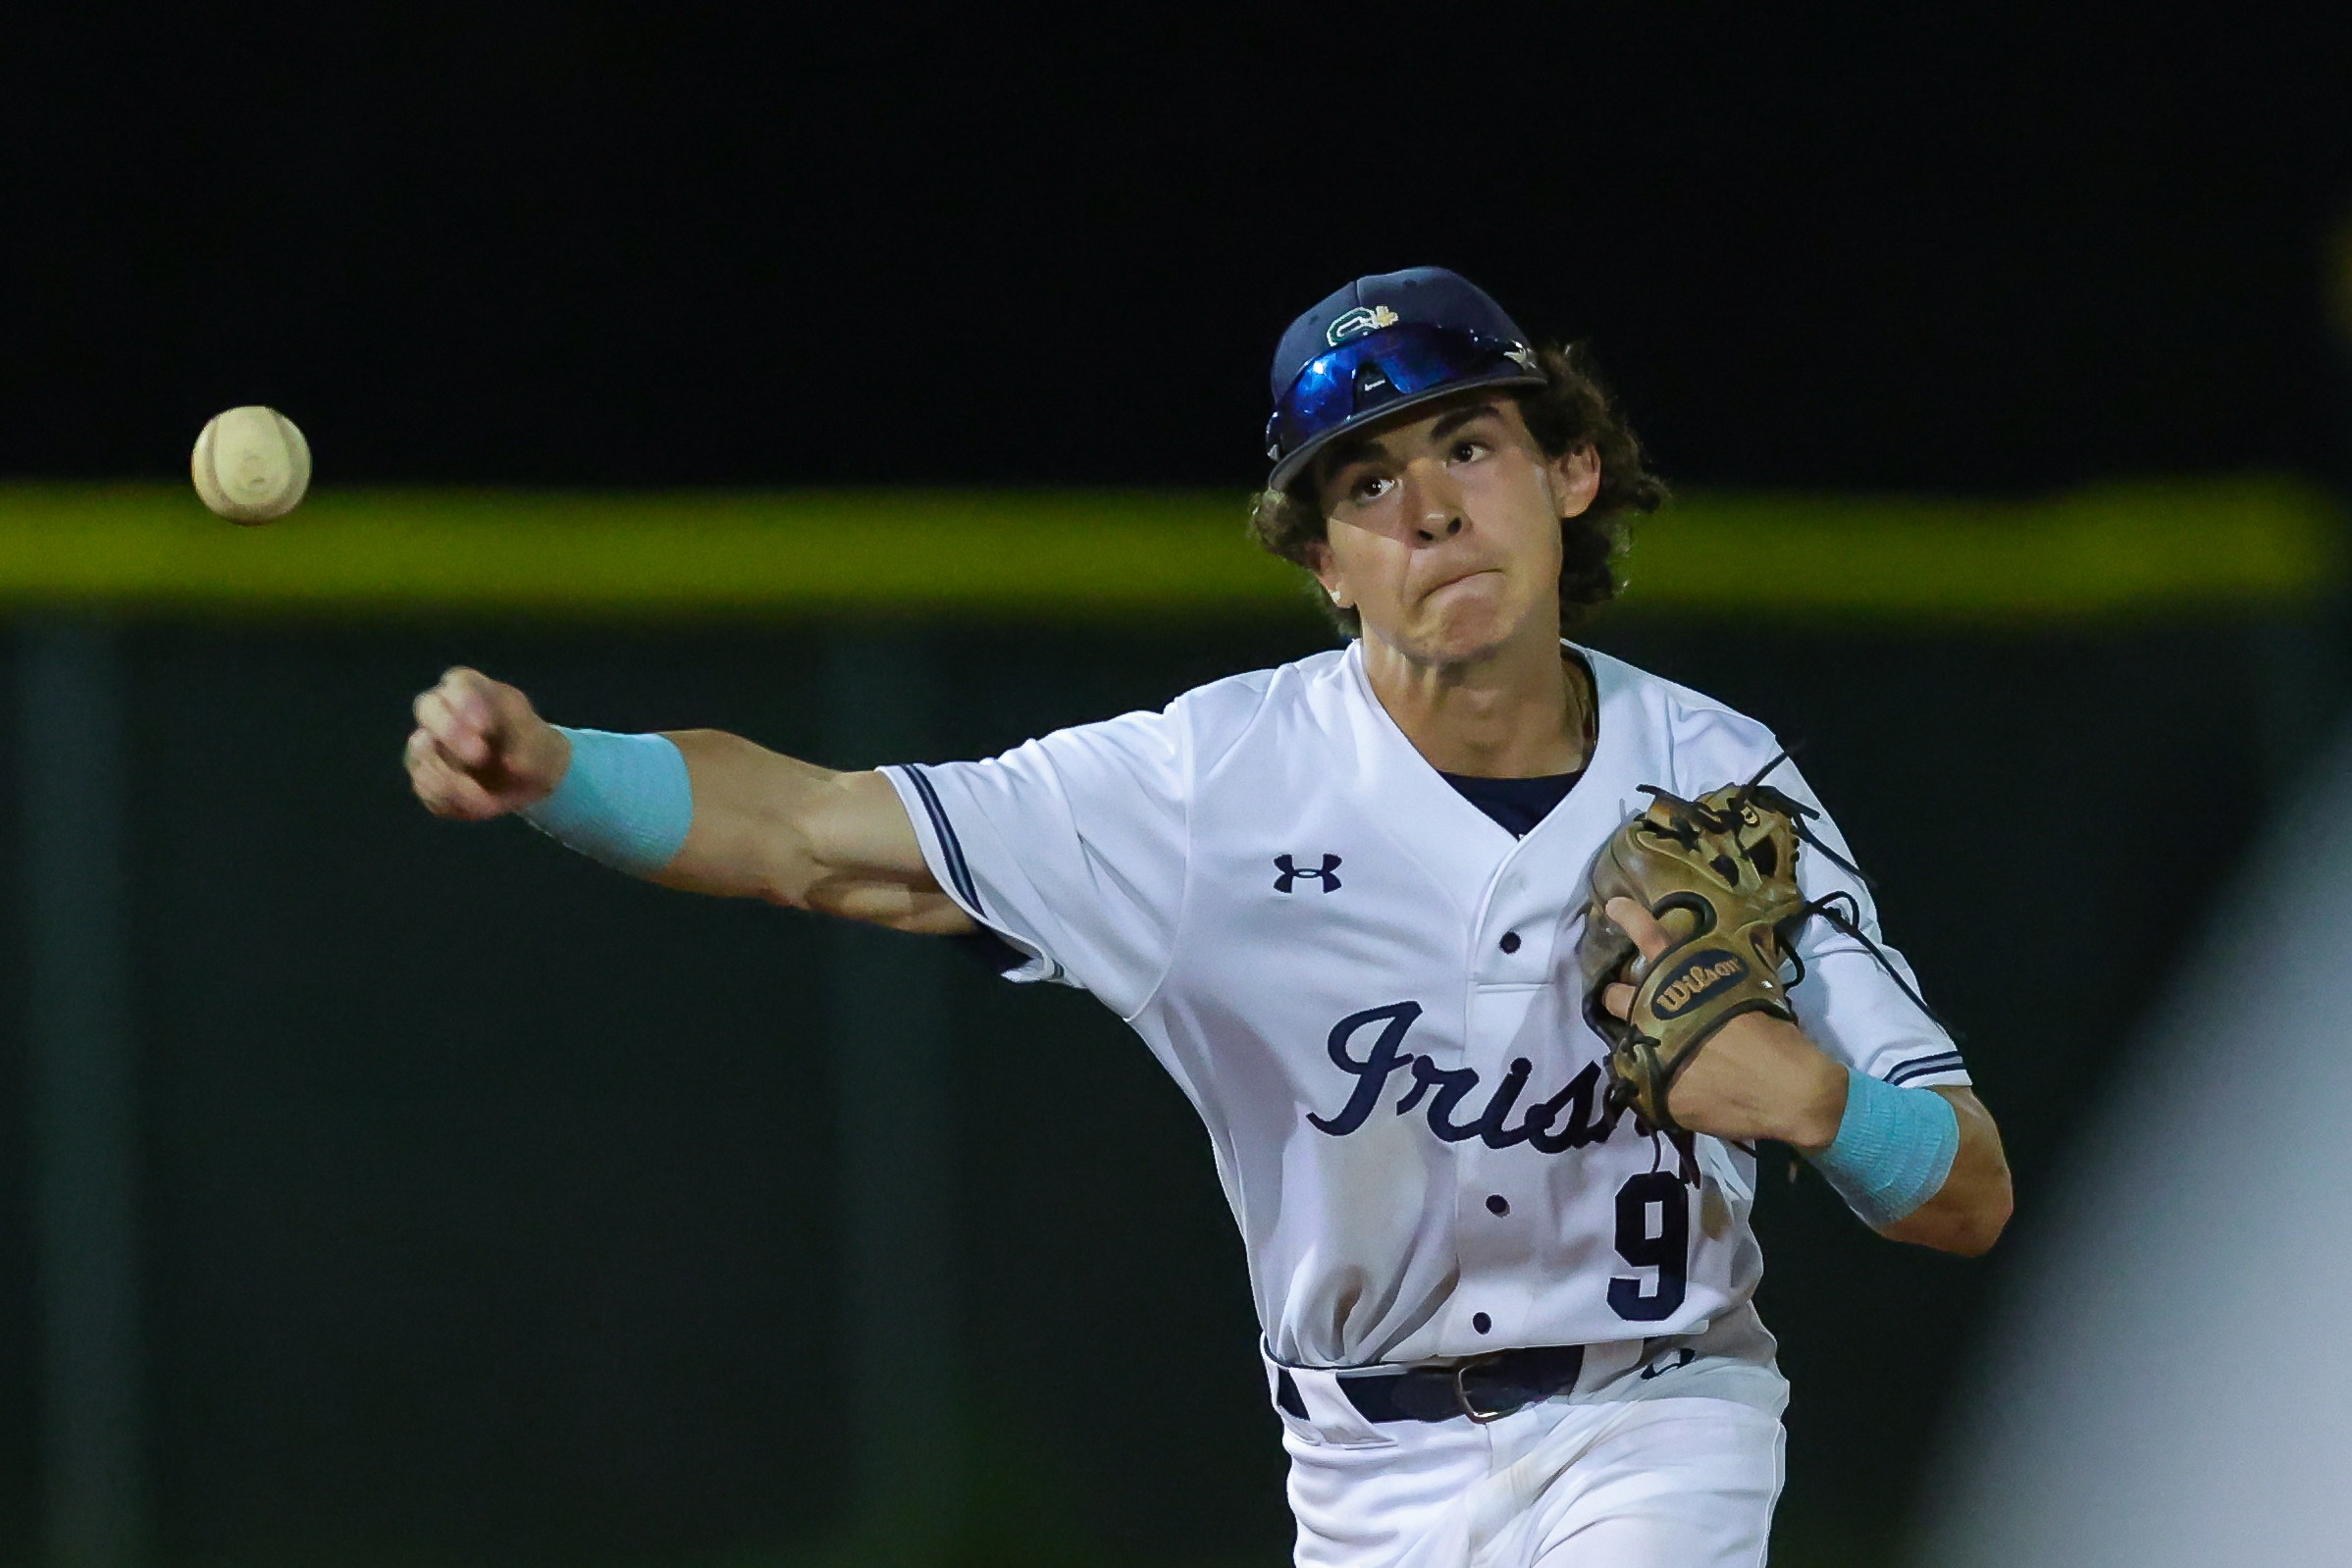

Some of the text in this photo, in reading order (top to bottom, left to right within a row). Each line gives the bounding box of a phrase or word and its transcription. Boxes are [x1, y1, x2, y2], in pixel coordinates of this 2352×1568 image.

[1656, 958, 1741, 1013] Wilson
[1305, 1000, 1652, 1154] Iris
[1606, 1171, 1689, 1322] 9
